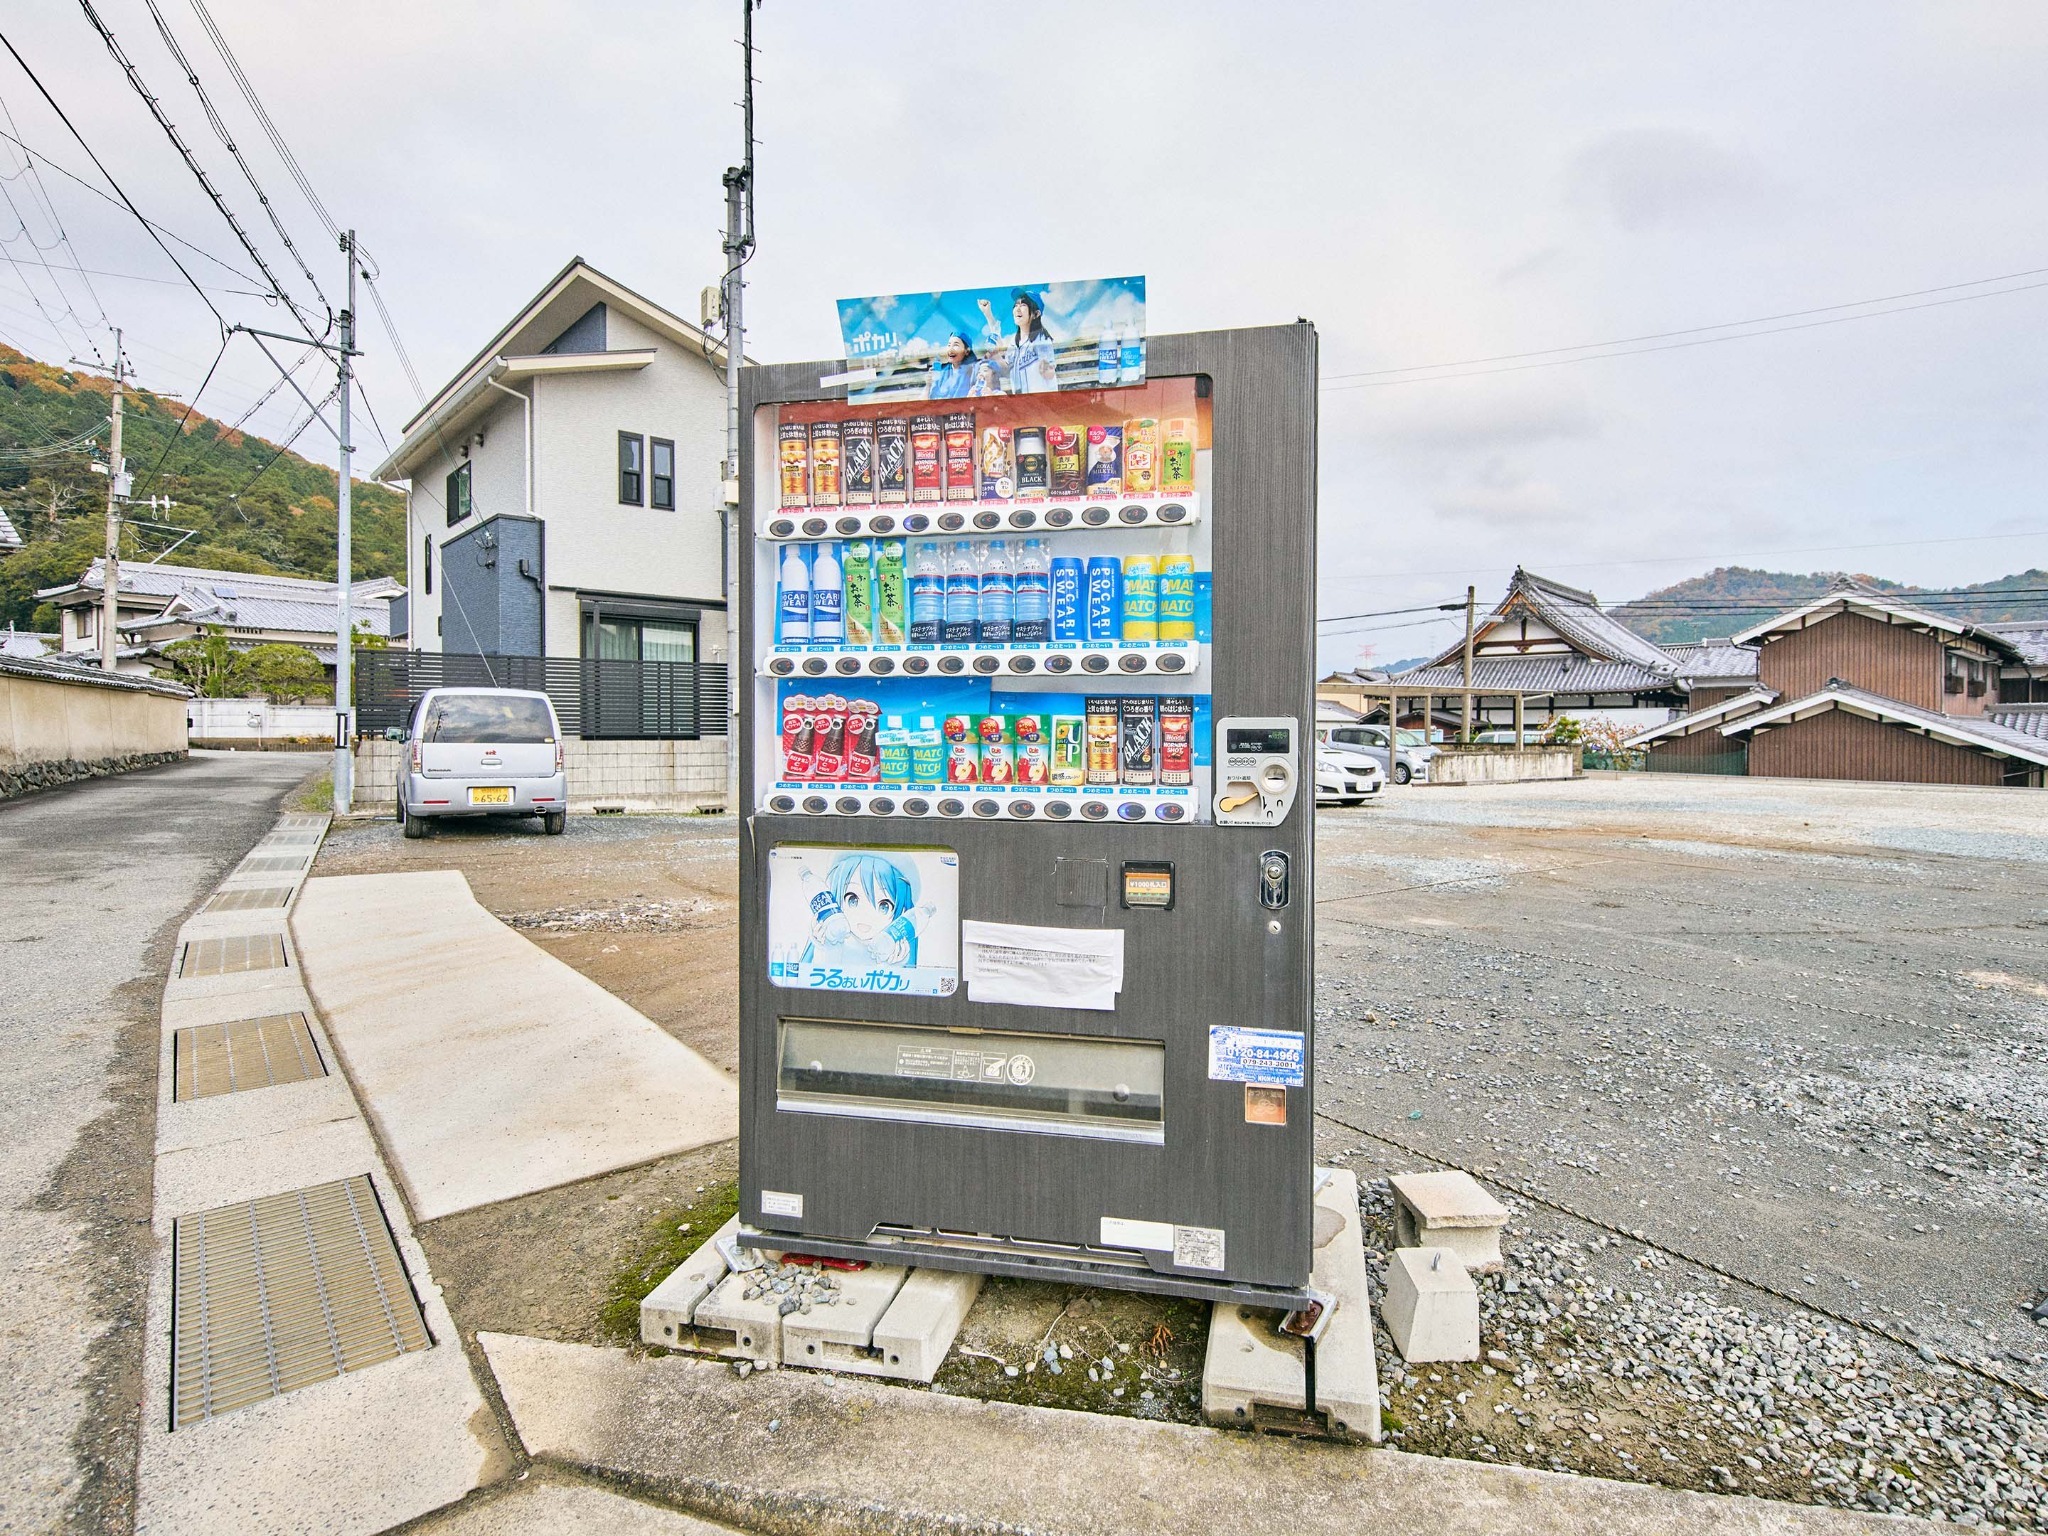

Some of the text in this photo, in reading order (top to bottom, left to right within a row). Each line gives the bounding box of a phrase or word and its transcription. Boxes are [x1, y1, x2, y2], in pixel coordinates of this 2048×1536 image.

[845, 439, 872, 485] BLACK
[879, 436, 905, 483] BLACK
[1056, 569, 1065, 629] SWEAT
[1065, 568, 1075, 636] POCARI
[1092, 568, 1101, 628] SWEAT
[1101, 568, 1110, 636] POCARI
[1161, 600, 1194, 611] MATC
[1125, 717, 1152, 763] BLACK
[809, 968, 911, 991] うるおいポカリ
